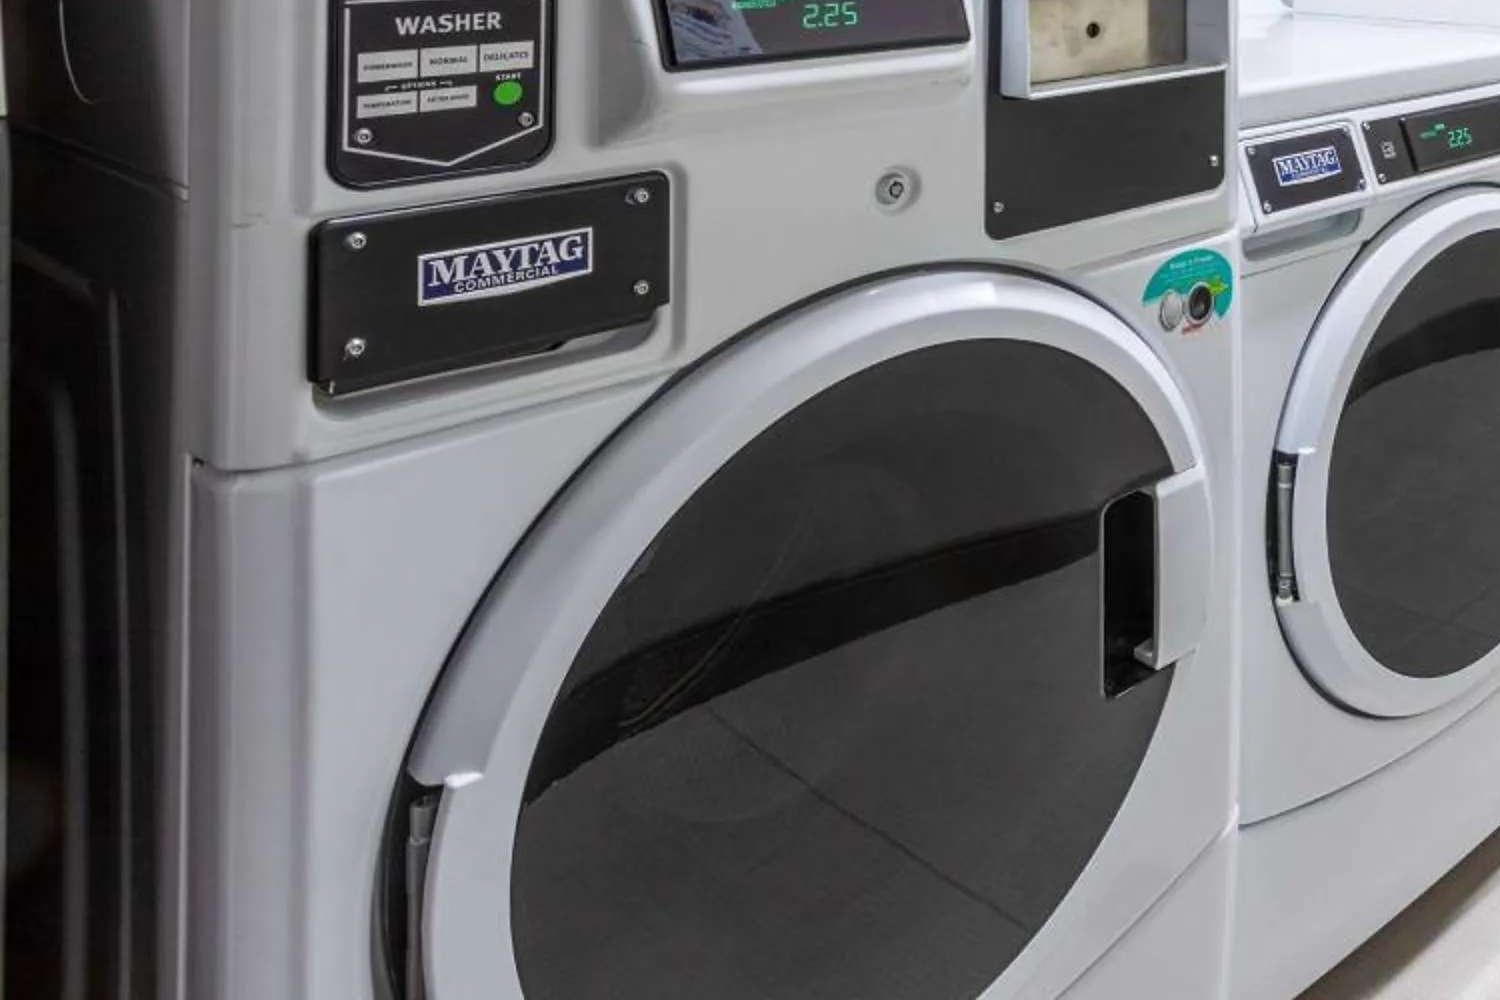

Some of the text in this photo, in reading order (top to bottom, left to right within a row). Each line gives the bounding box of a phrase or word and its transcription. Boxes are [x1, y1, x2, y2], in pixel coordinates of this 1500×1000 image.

[395, 11, 502, 36] WASHER
[802, 1, 858, 29] 2.25
[1278, 150, 1338, 177] MAYTAG
[427, 235, 585, 287] MAYTAG
[453, 265, 559, 293] COMMERCIAL
